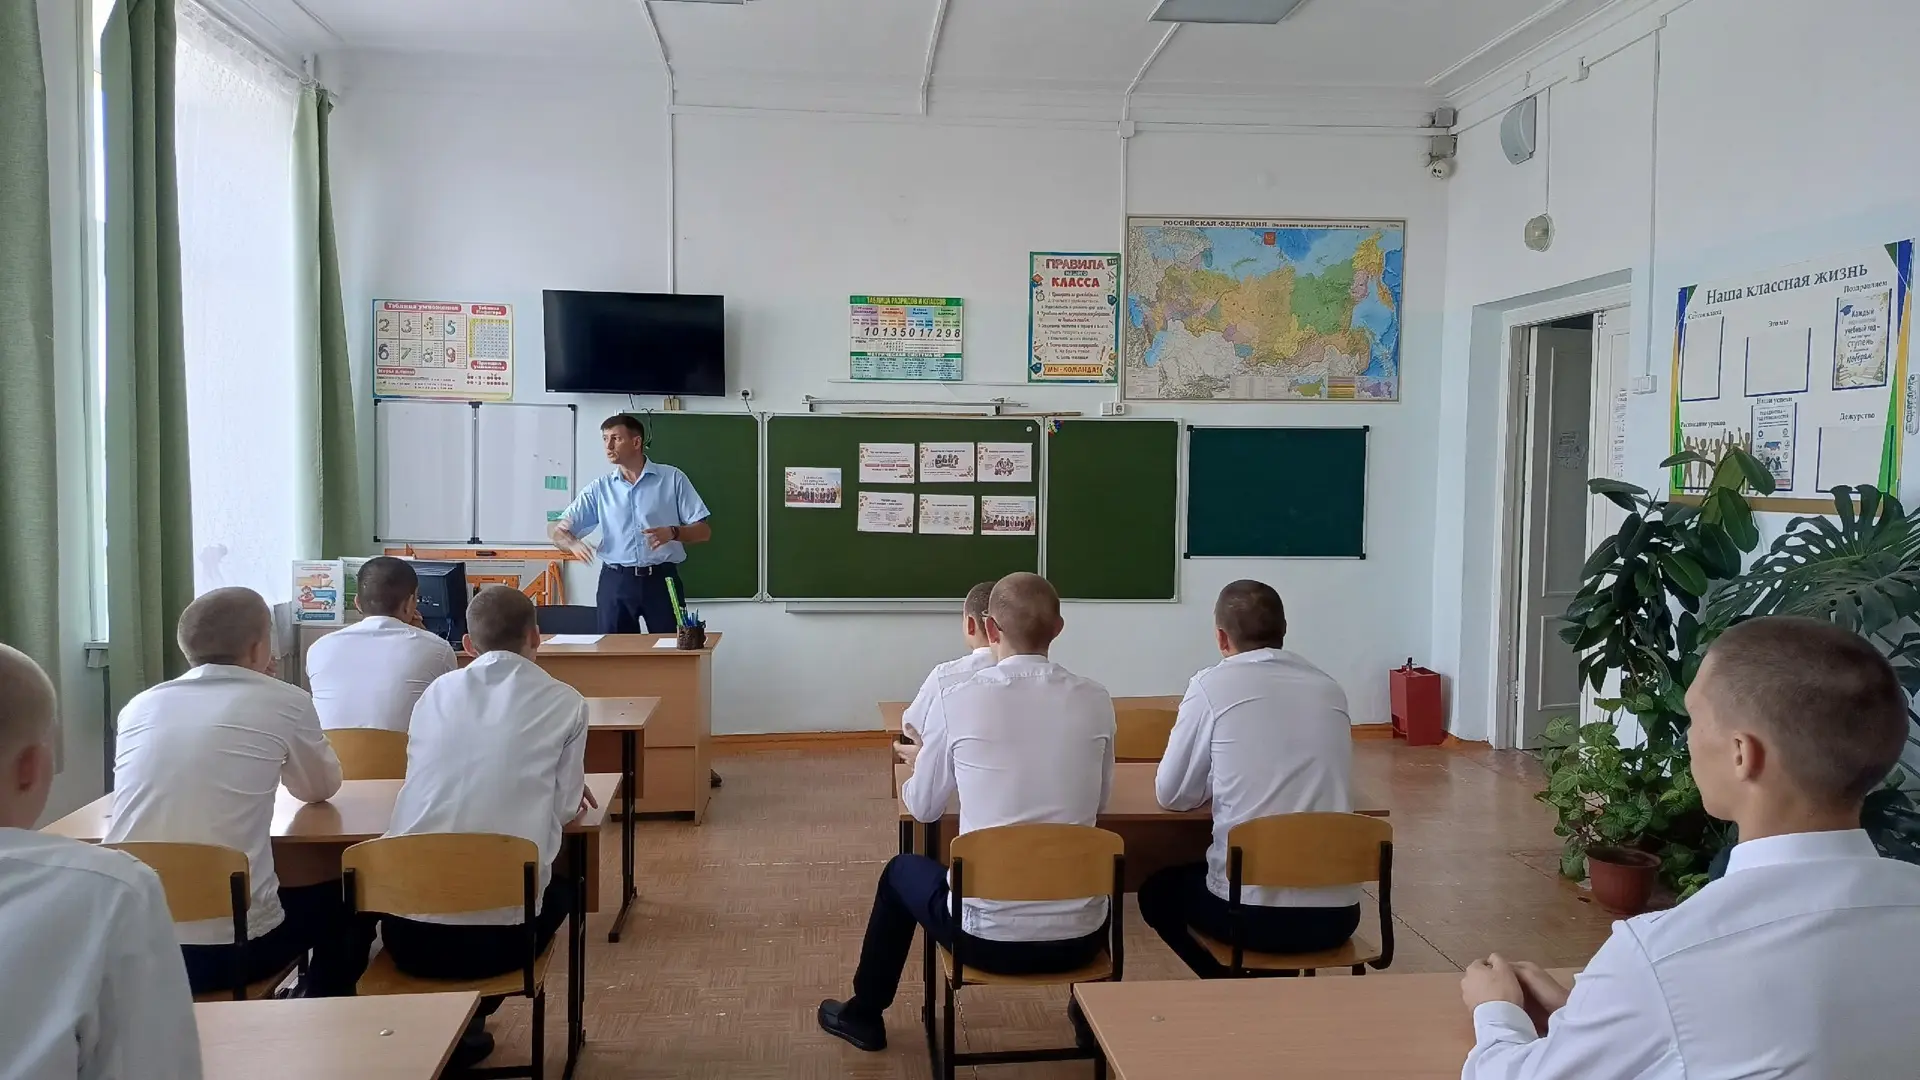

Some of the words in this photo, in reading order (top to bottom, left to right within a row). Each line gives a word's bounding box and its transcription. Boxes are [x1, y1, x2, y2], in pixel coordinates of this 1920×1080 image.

[1163, 219, 1216, 227] РОССИЙСКАЯ
[1046, 258, 1105, 270] ПРАВИЛА
[1051, 277, 1100, 288] КЛАССА
[1706, 287, 1743, 305] Наша
[1746, 274, 1811, 298] классная
[1813, 264, 1868, 285] жизнь
[378, 318, 390, 332] 2
[401, 319, 412, 333] 3
[446, 319, 456, 335] 5
[378, 343, 390, 360] 6
[401, 346, 412, 360] 7
[446, 346, 456, 363] 9
